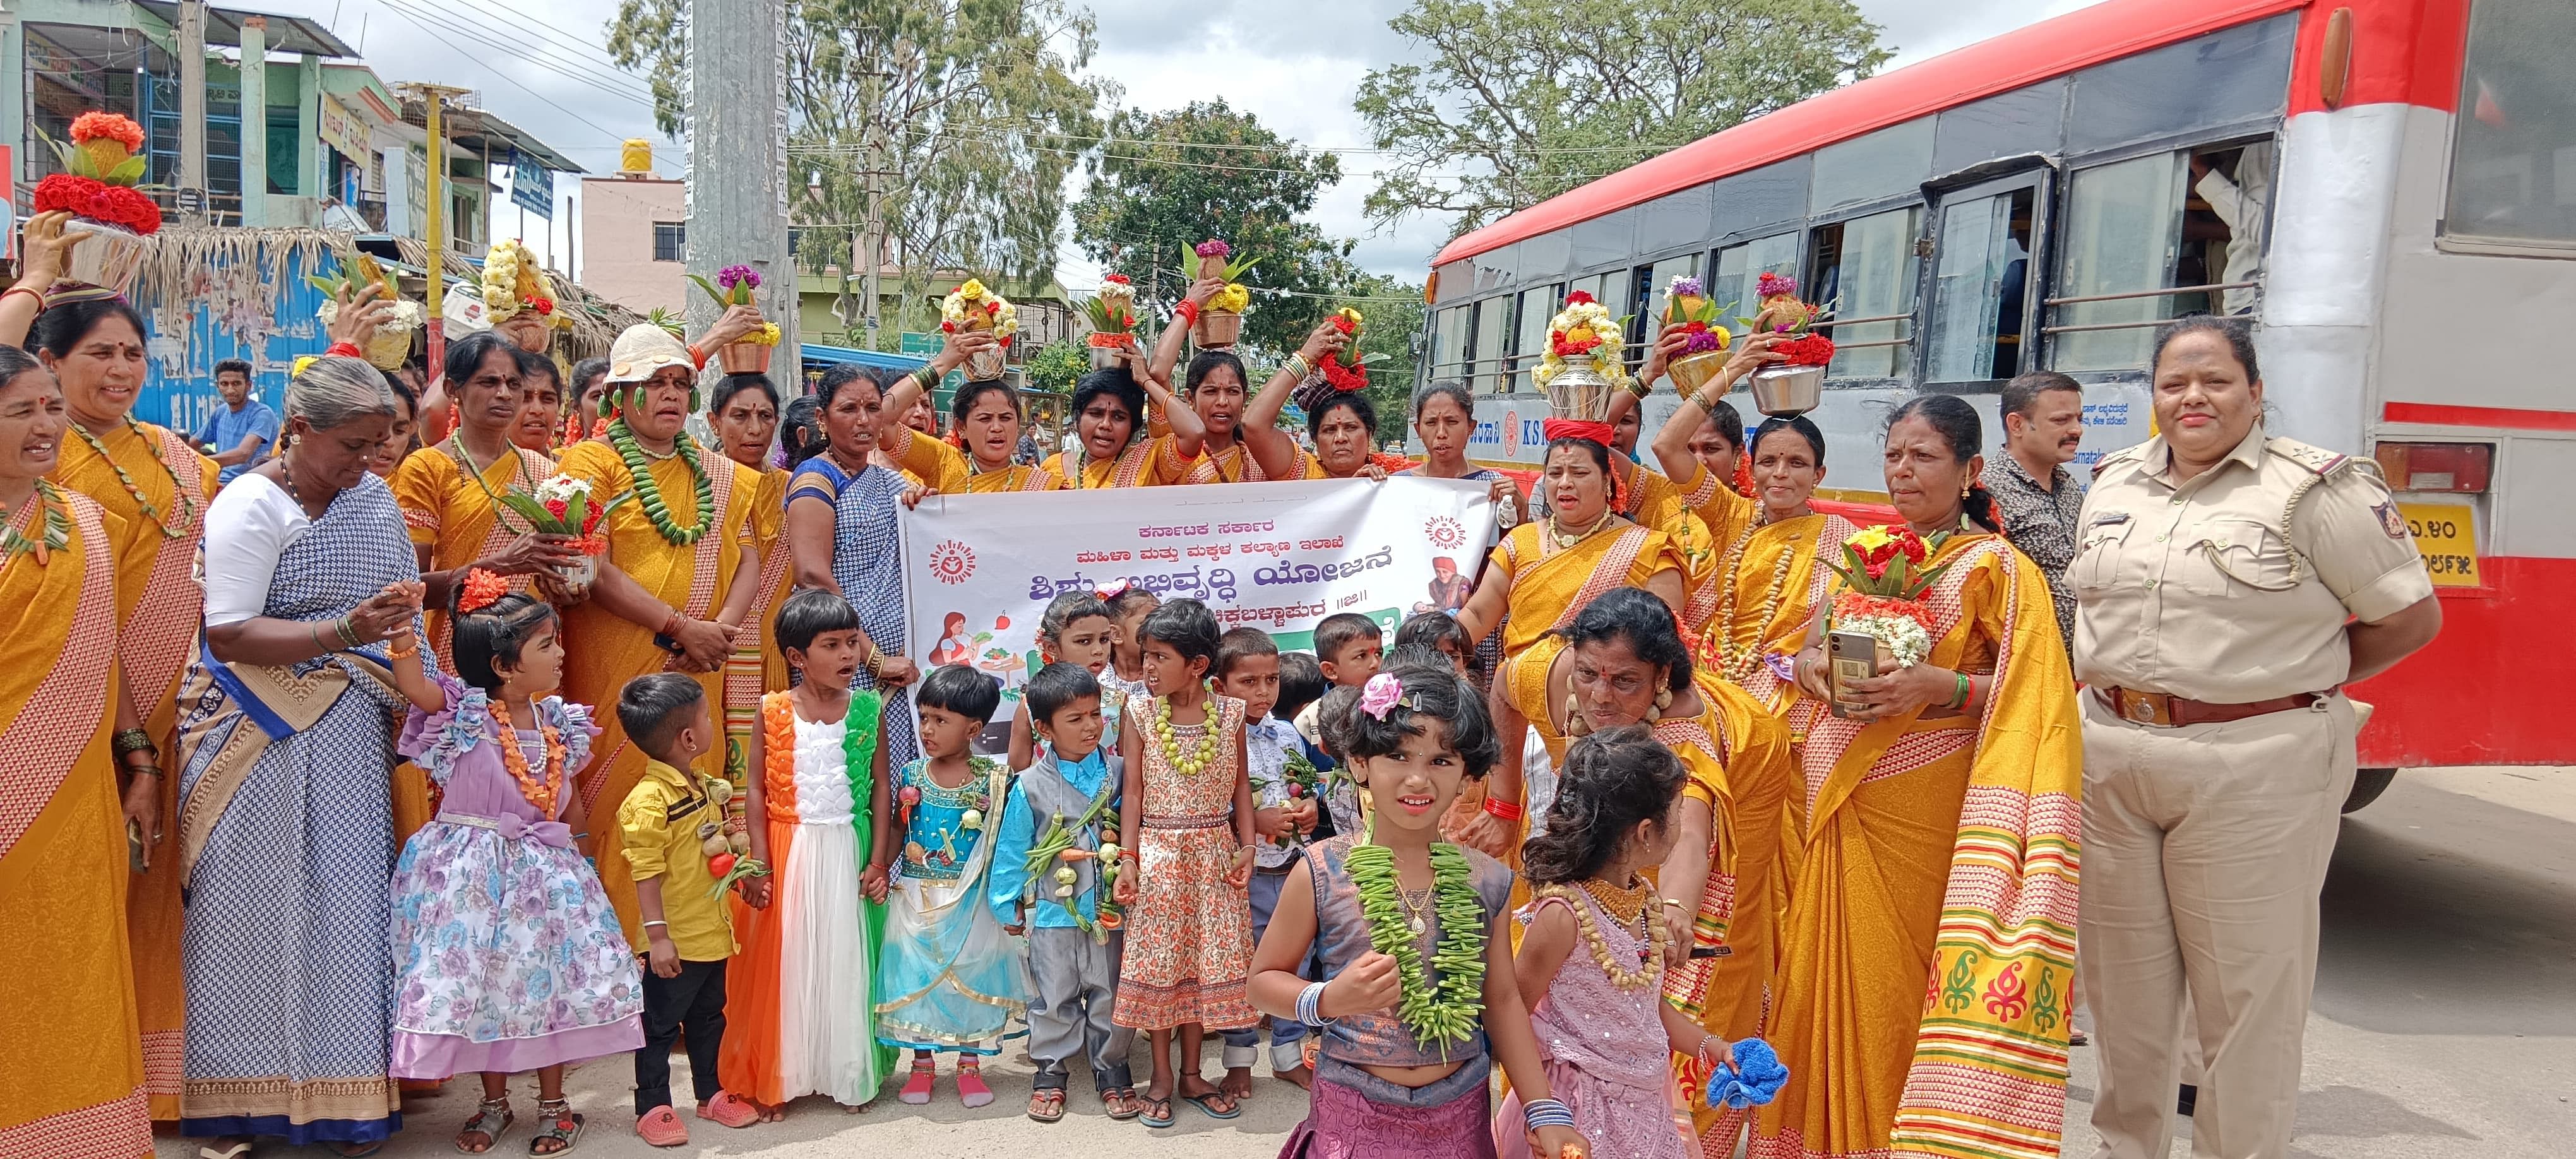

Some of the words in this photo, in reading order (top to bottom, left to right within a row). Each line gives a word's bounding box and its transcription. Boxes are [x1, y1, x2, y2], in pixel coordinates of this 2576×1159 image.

[1139, 522, 1209, 537] ಕರ್ನಾಟಕ
[1219, 519, 1274, 535] ಸರ್ಕಾರ
[1076, 549, 1131, 563] ಮಹಿಳಾ
[1140, 546, 1179, 562] ಮತ್ತು
[1187, 543, 1231, 561] ಮಕ್ಕಳ
[1241, 540, 1291, 557] ಕಲ್ಯಾಣ
[1299, 535, 1344, 550] ಇಲಾಖೆ
[1254, 545, 1392, 586] ಯೋಜನೆ
